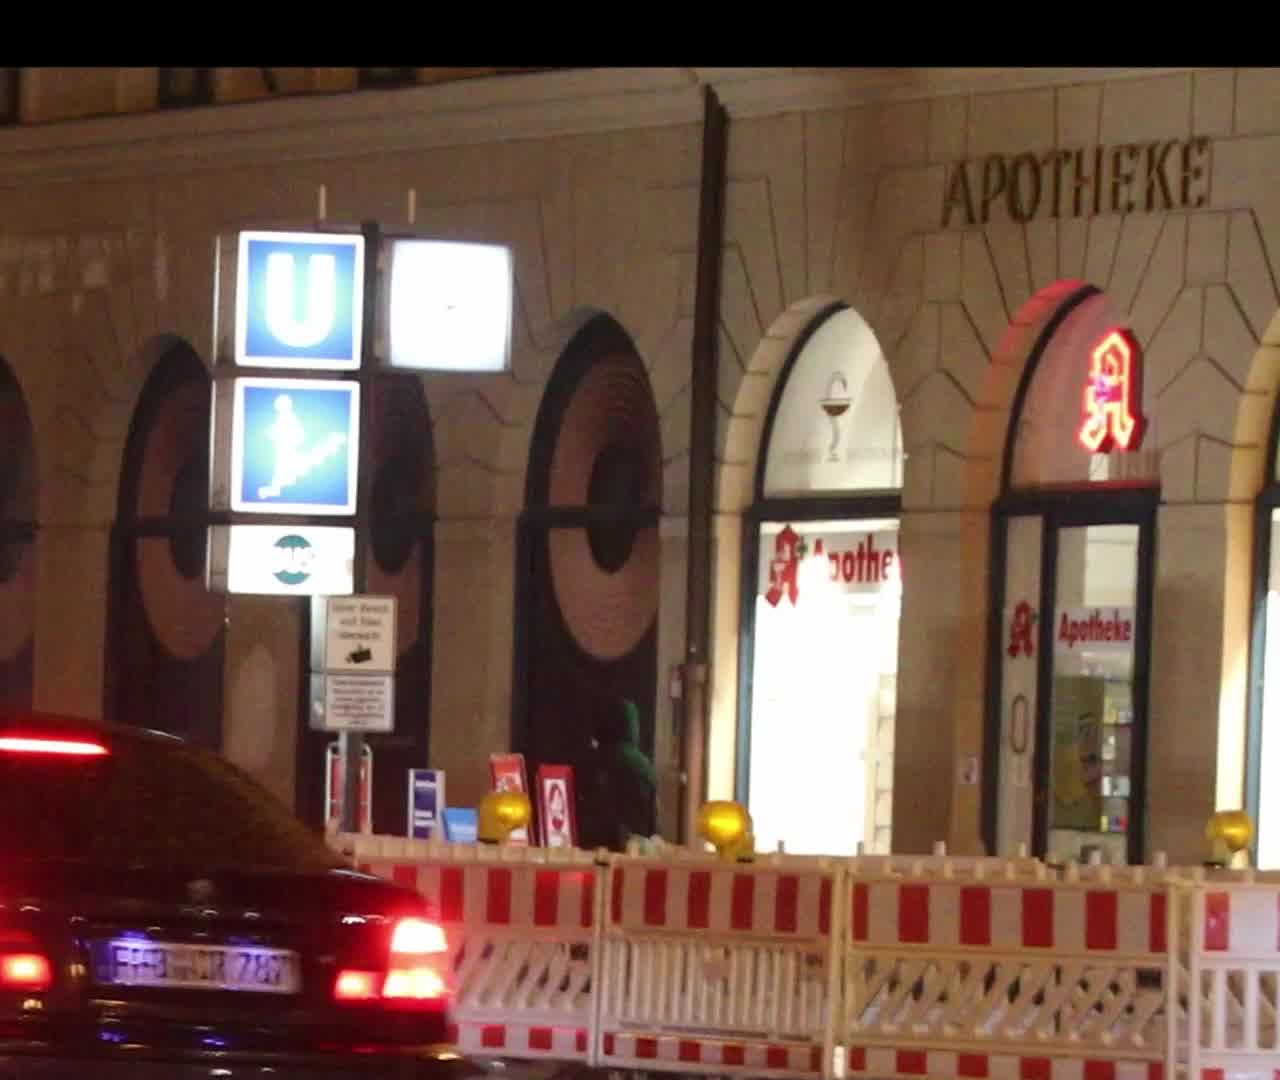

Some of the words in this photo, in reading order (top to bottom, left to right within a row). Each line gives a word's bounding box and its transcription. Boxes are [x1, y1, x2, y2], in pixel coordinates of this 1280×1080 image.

[940, 135, 1212, 228] APOTHEKE
[264, 250, 337, 348] U
[1057, 608, 1132, 649] Apotheke
